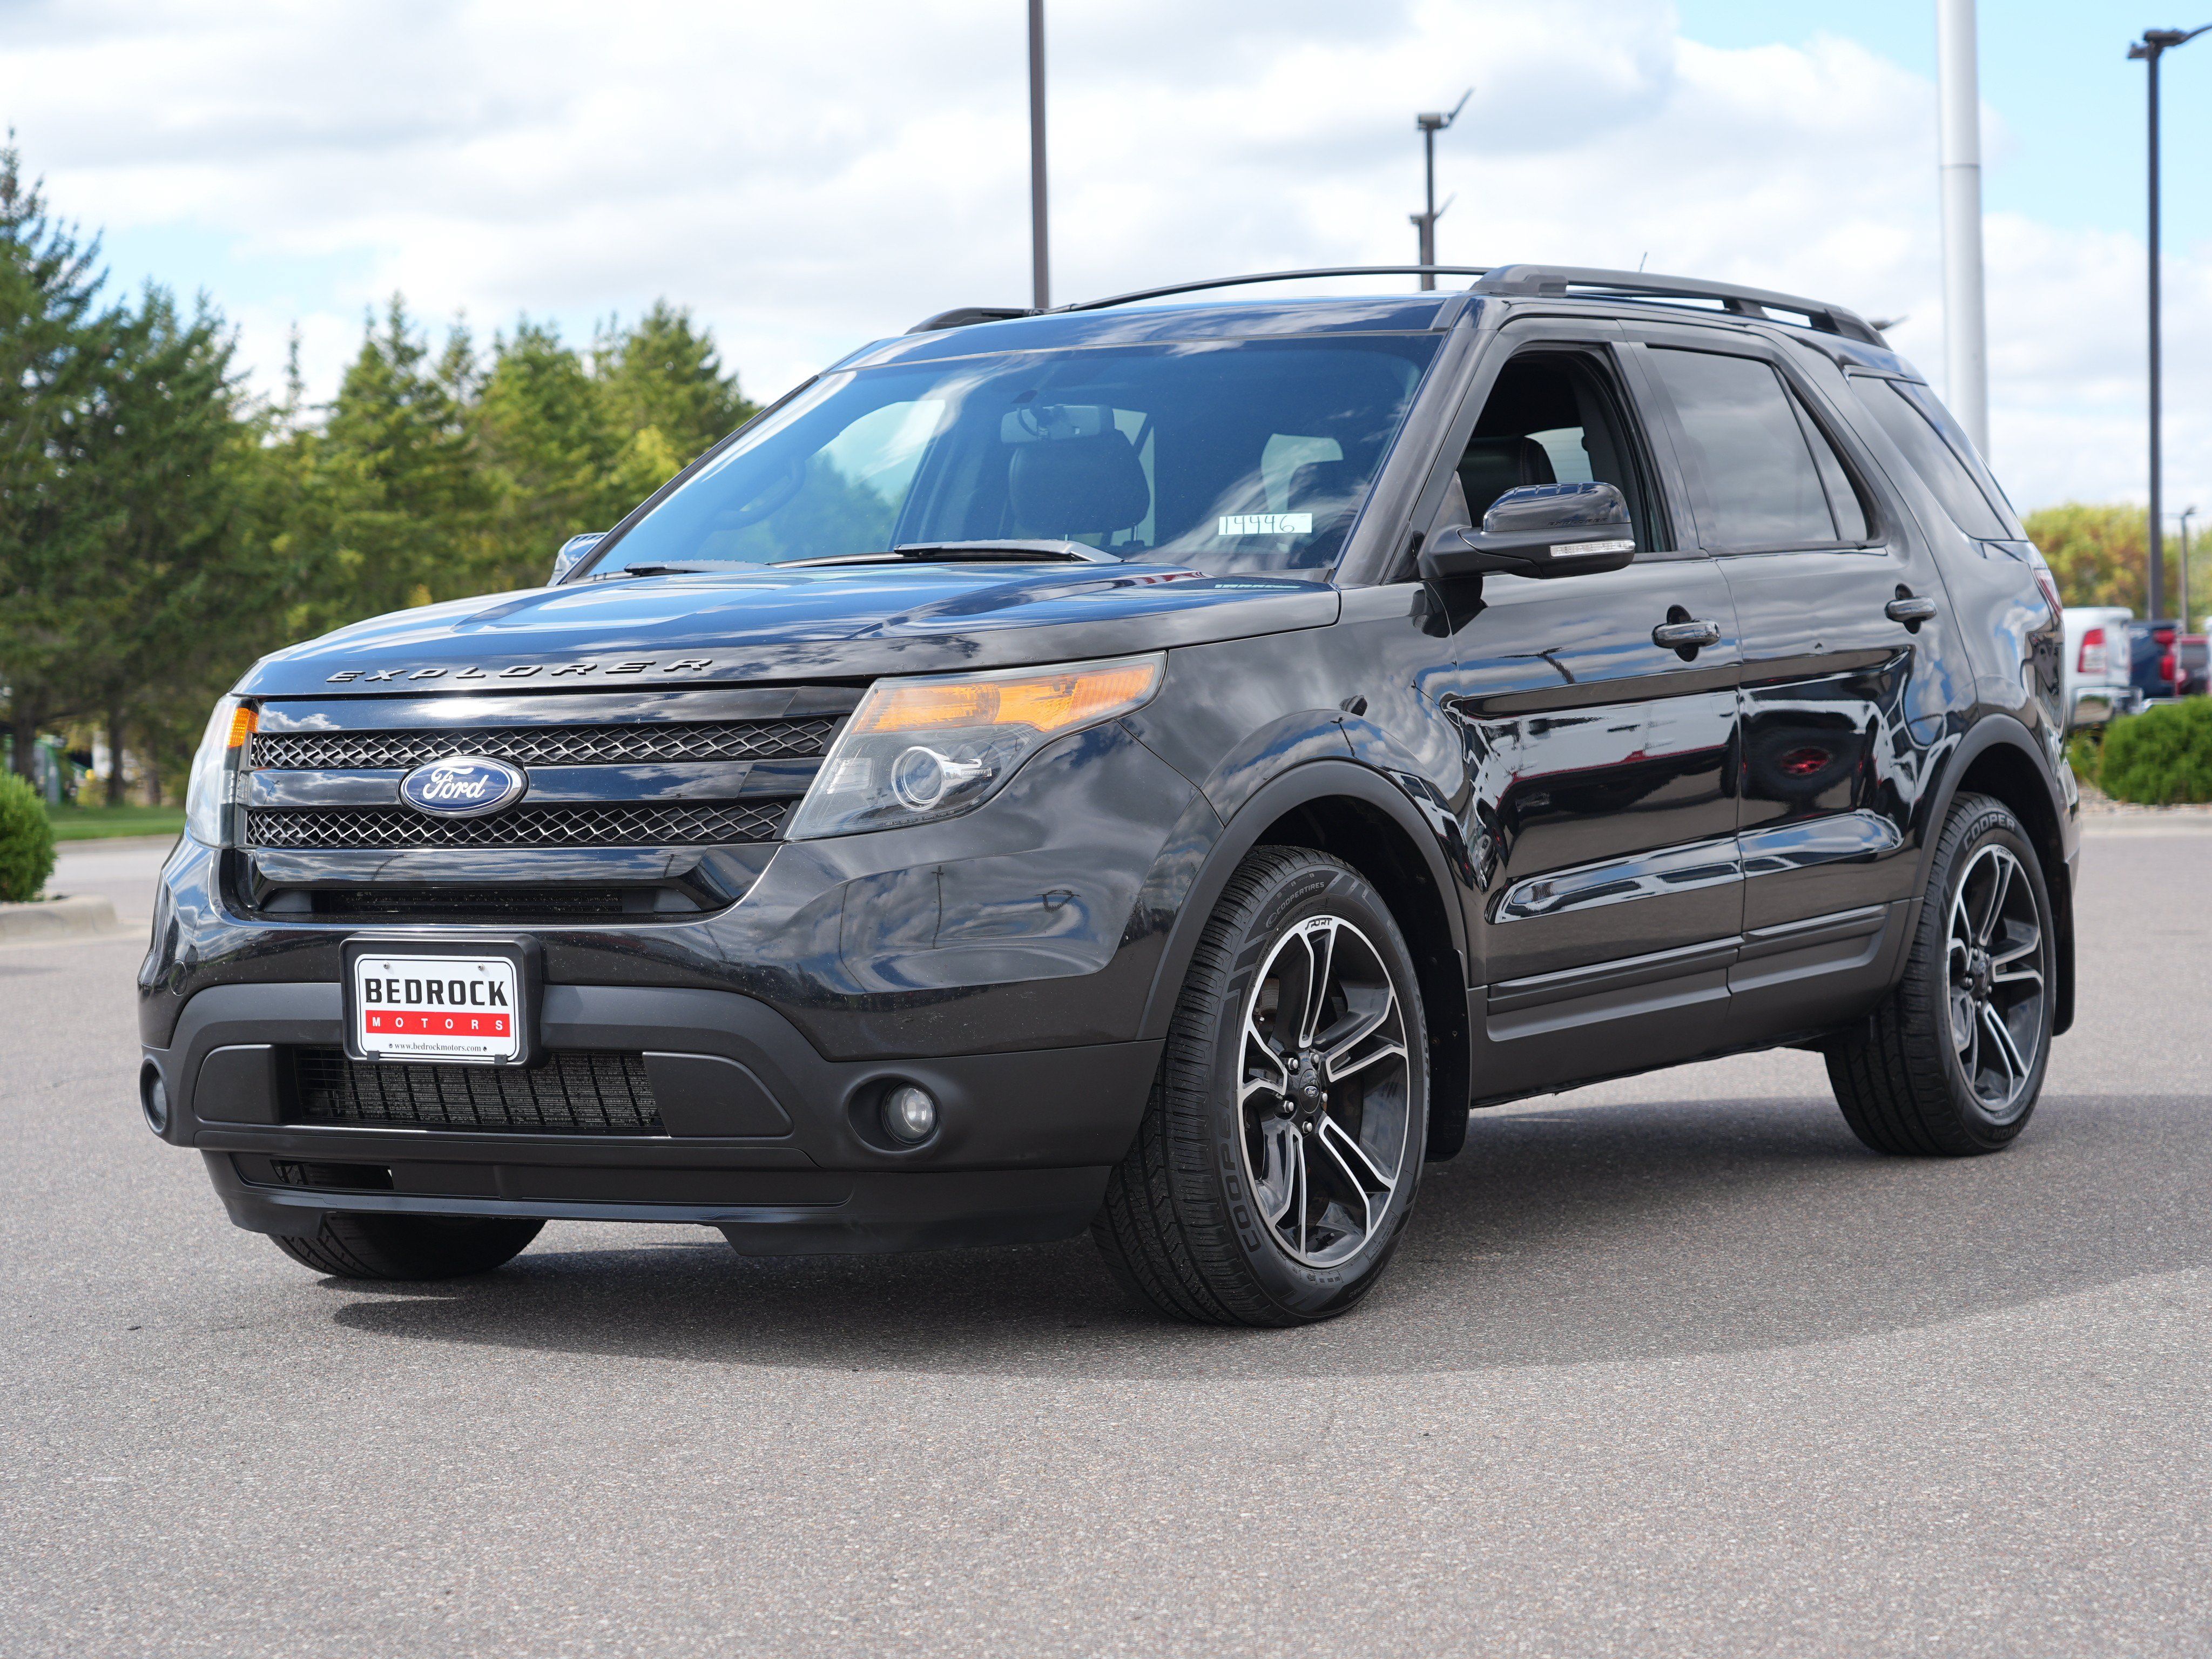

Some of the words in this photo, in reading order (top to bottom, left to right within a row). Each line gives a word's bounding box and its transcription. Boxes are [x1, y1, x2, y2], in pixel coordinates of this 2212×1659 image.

[1225, 515, 1295, 534] 14446
[326, 658, 713, 683] EXPLORER
[422, 766, 486, 800] Ford
[1964, 813, 2015, 851] COOPER
[1305, 918, 1333, 930] SPORT
[365, 978, 508, 1006] BEDROCK
[372, 1016, 503, 1030] MOTORS
[394, 1042, 481, 1053] www.bedrockmotors.com
[1217, 1080, 1262, 1253] COOPER
